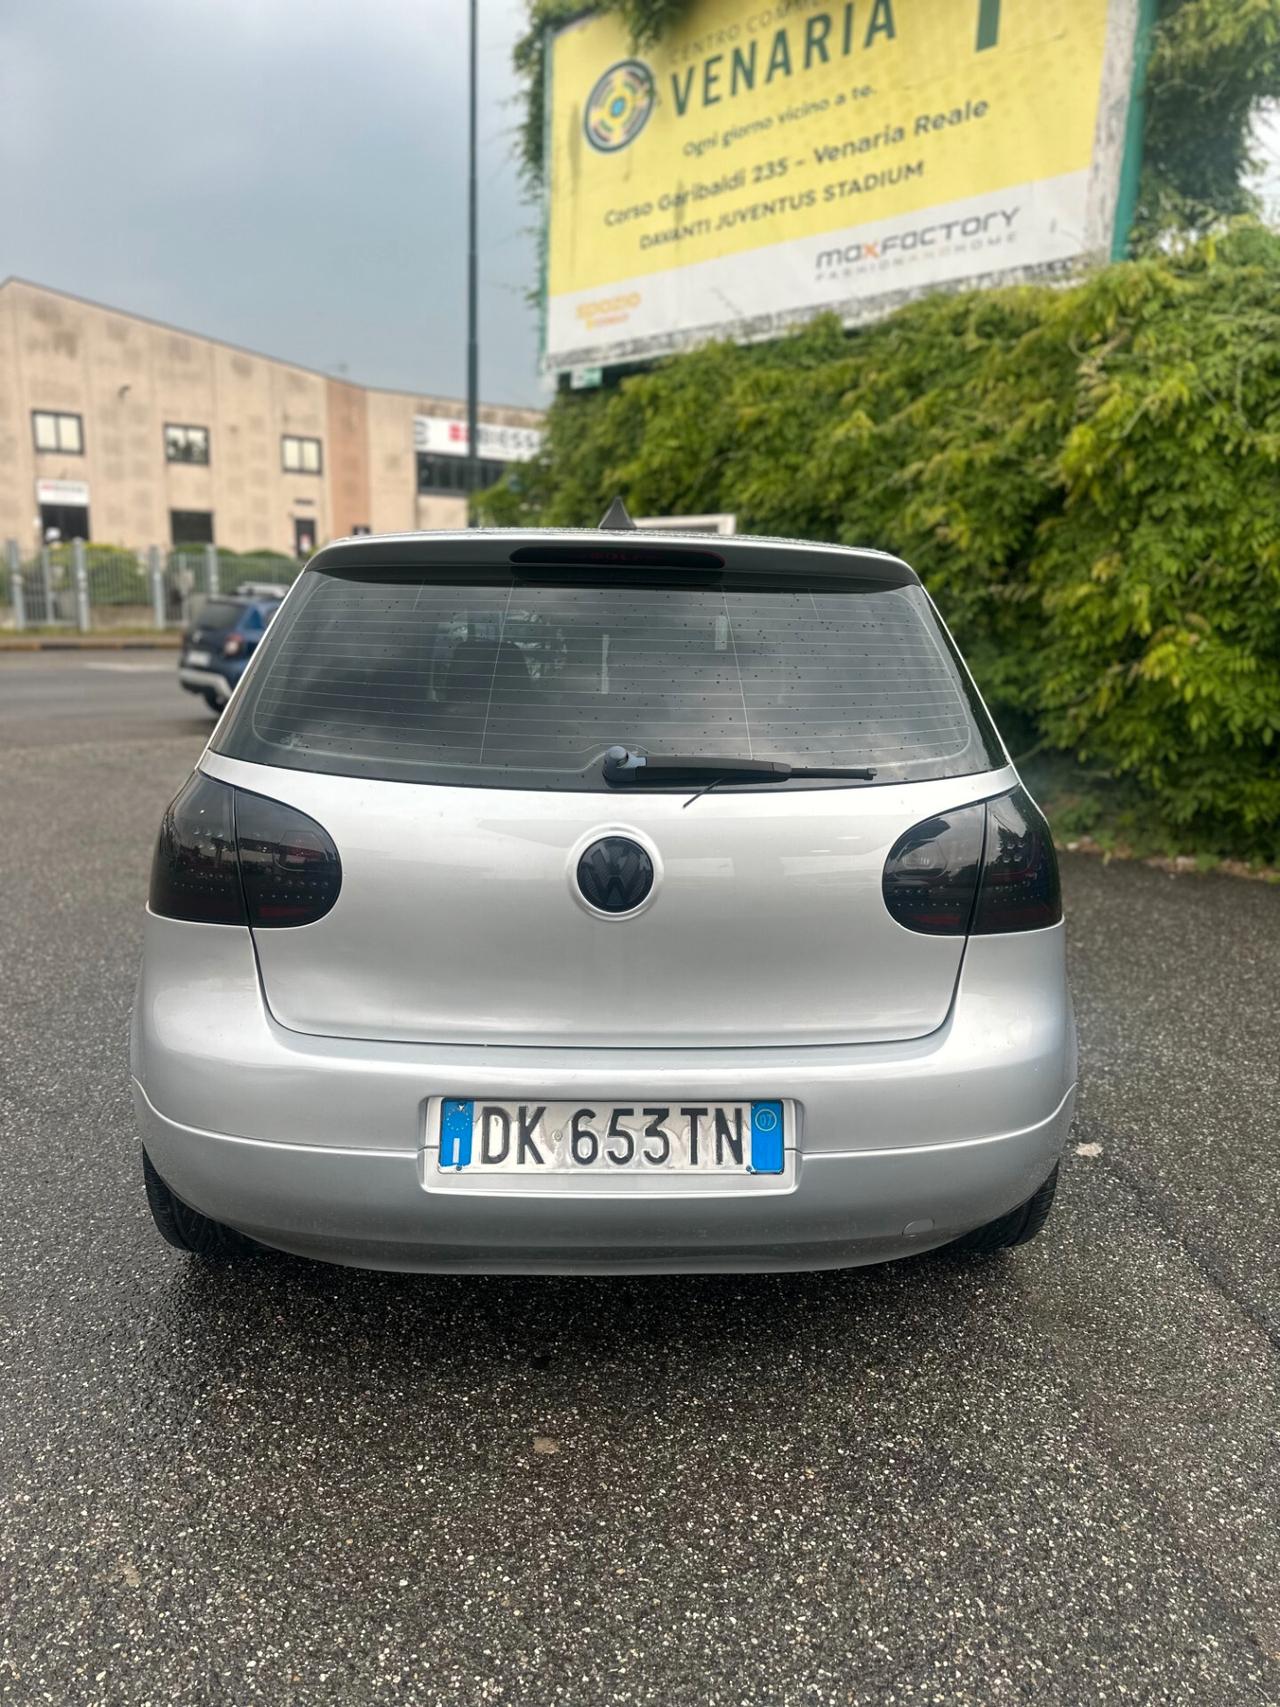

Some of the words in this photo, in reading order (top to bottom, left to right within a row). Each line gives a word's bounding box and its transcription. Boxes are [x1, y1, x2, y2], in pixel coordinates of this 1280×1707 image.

[671, 0, 896, 117] VENARIA
[604, 200, 654, 228] Corso
[657, 169, 747, 212] Garibaldi
[752, 156, 788, 184] 235
[813, 123, 905, 165] Venaria
[914, 99, 990, 136] Reale
[683, 134, 719, 158] Ogni
[721, 115, 773, 148] giorno
[777, 97, 830, 124] vicino
[835, 93, 847, 106] a
[639, 219, 712, 252] DAVANTI
[714, 188, 817, 232] JUVENTUS
[823, 160, 924, 203] STADIUM
[481, 1106, 548, 1165] DK
